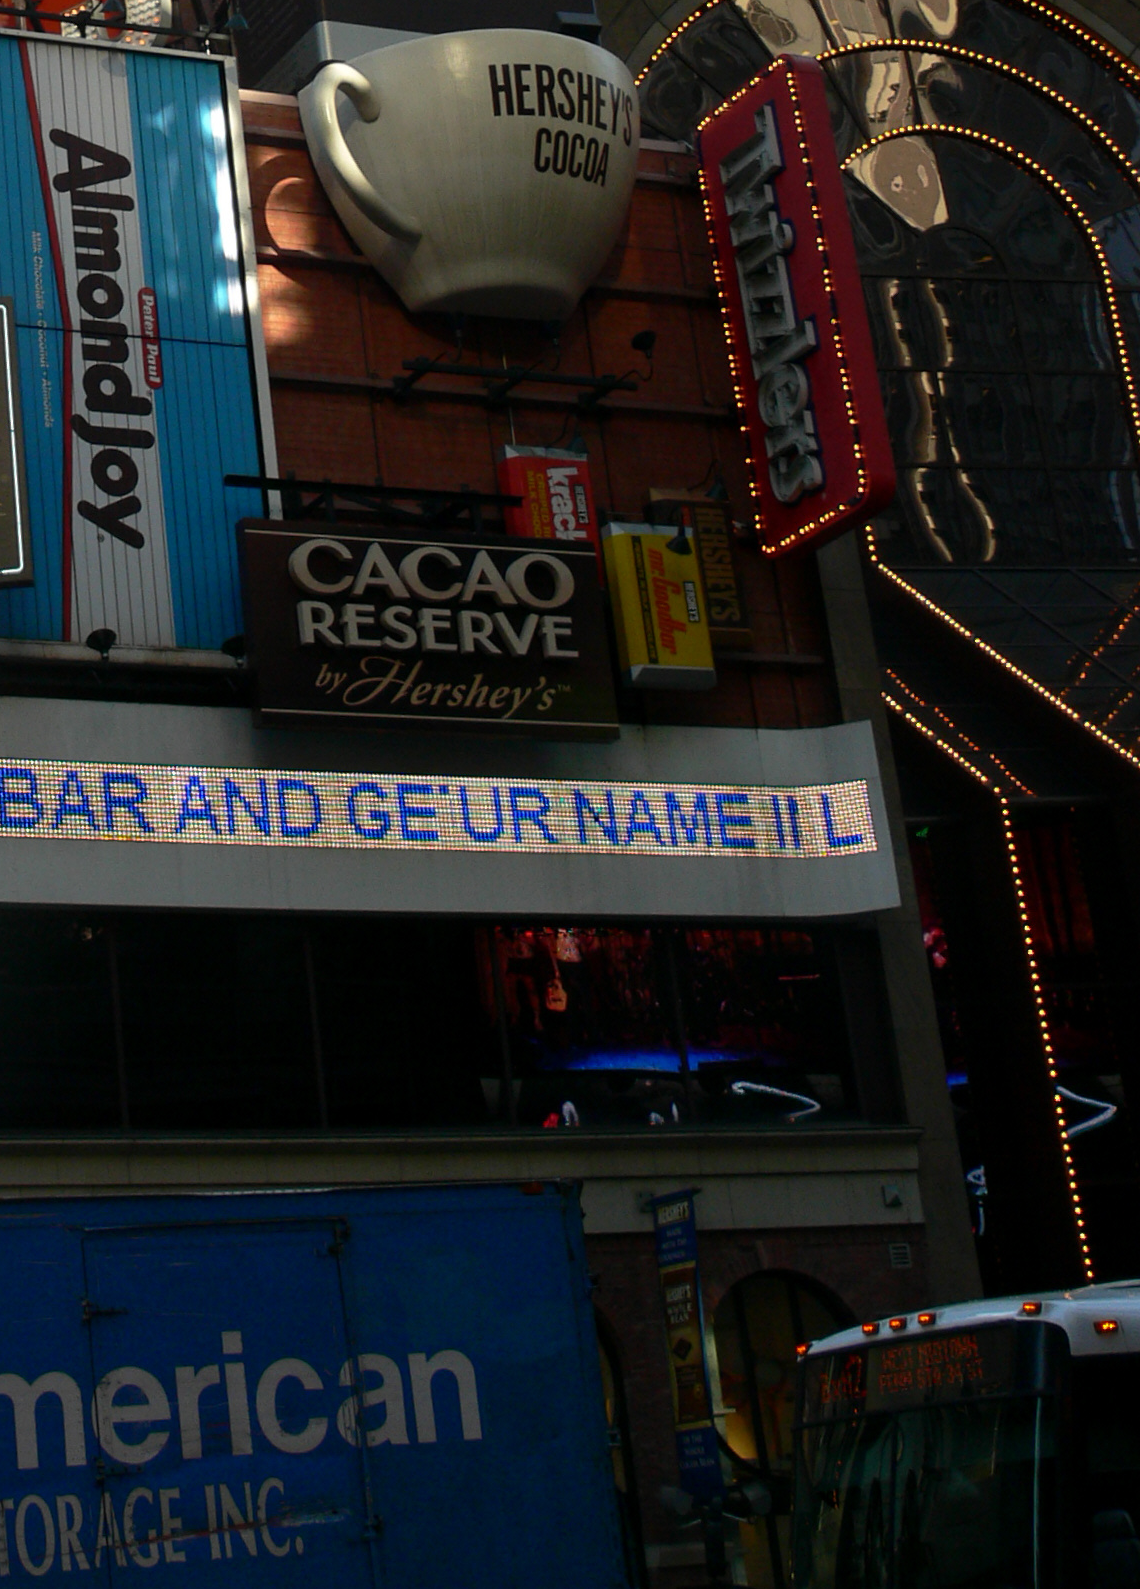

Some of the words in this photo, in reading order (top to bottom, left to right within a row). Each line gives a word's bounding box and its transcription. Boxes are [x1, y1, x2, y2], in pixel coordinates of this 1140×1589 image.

[488, 64, 633, 146] HERSHEY'S
[534, 127, 610, 187] COCOA
[49, 127, 153, 417] Almond
[142, 293, 155, 338] Peter
[146, 342, 161, 383] Paul
[70, 413, 155, 550] Joy
[288, 538, 575, 609] CACAO
[695, 507, 741, 622] HERSHEY'S
[296, 600, 579, 658] RESERVE
[315, 663, 347, 694] by
[342, 655, 558, 720] Hershey's
[175, 774, 322, 838] AND
[573, 787, 755, 849] NAME
[205, 1477, 304, 1562] INC.
